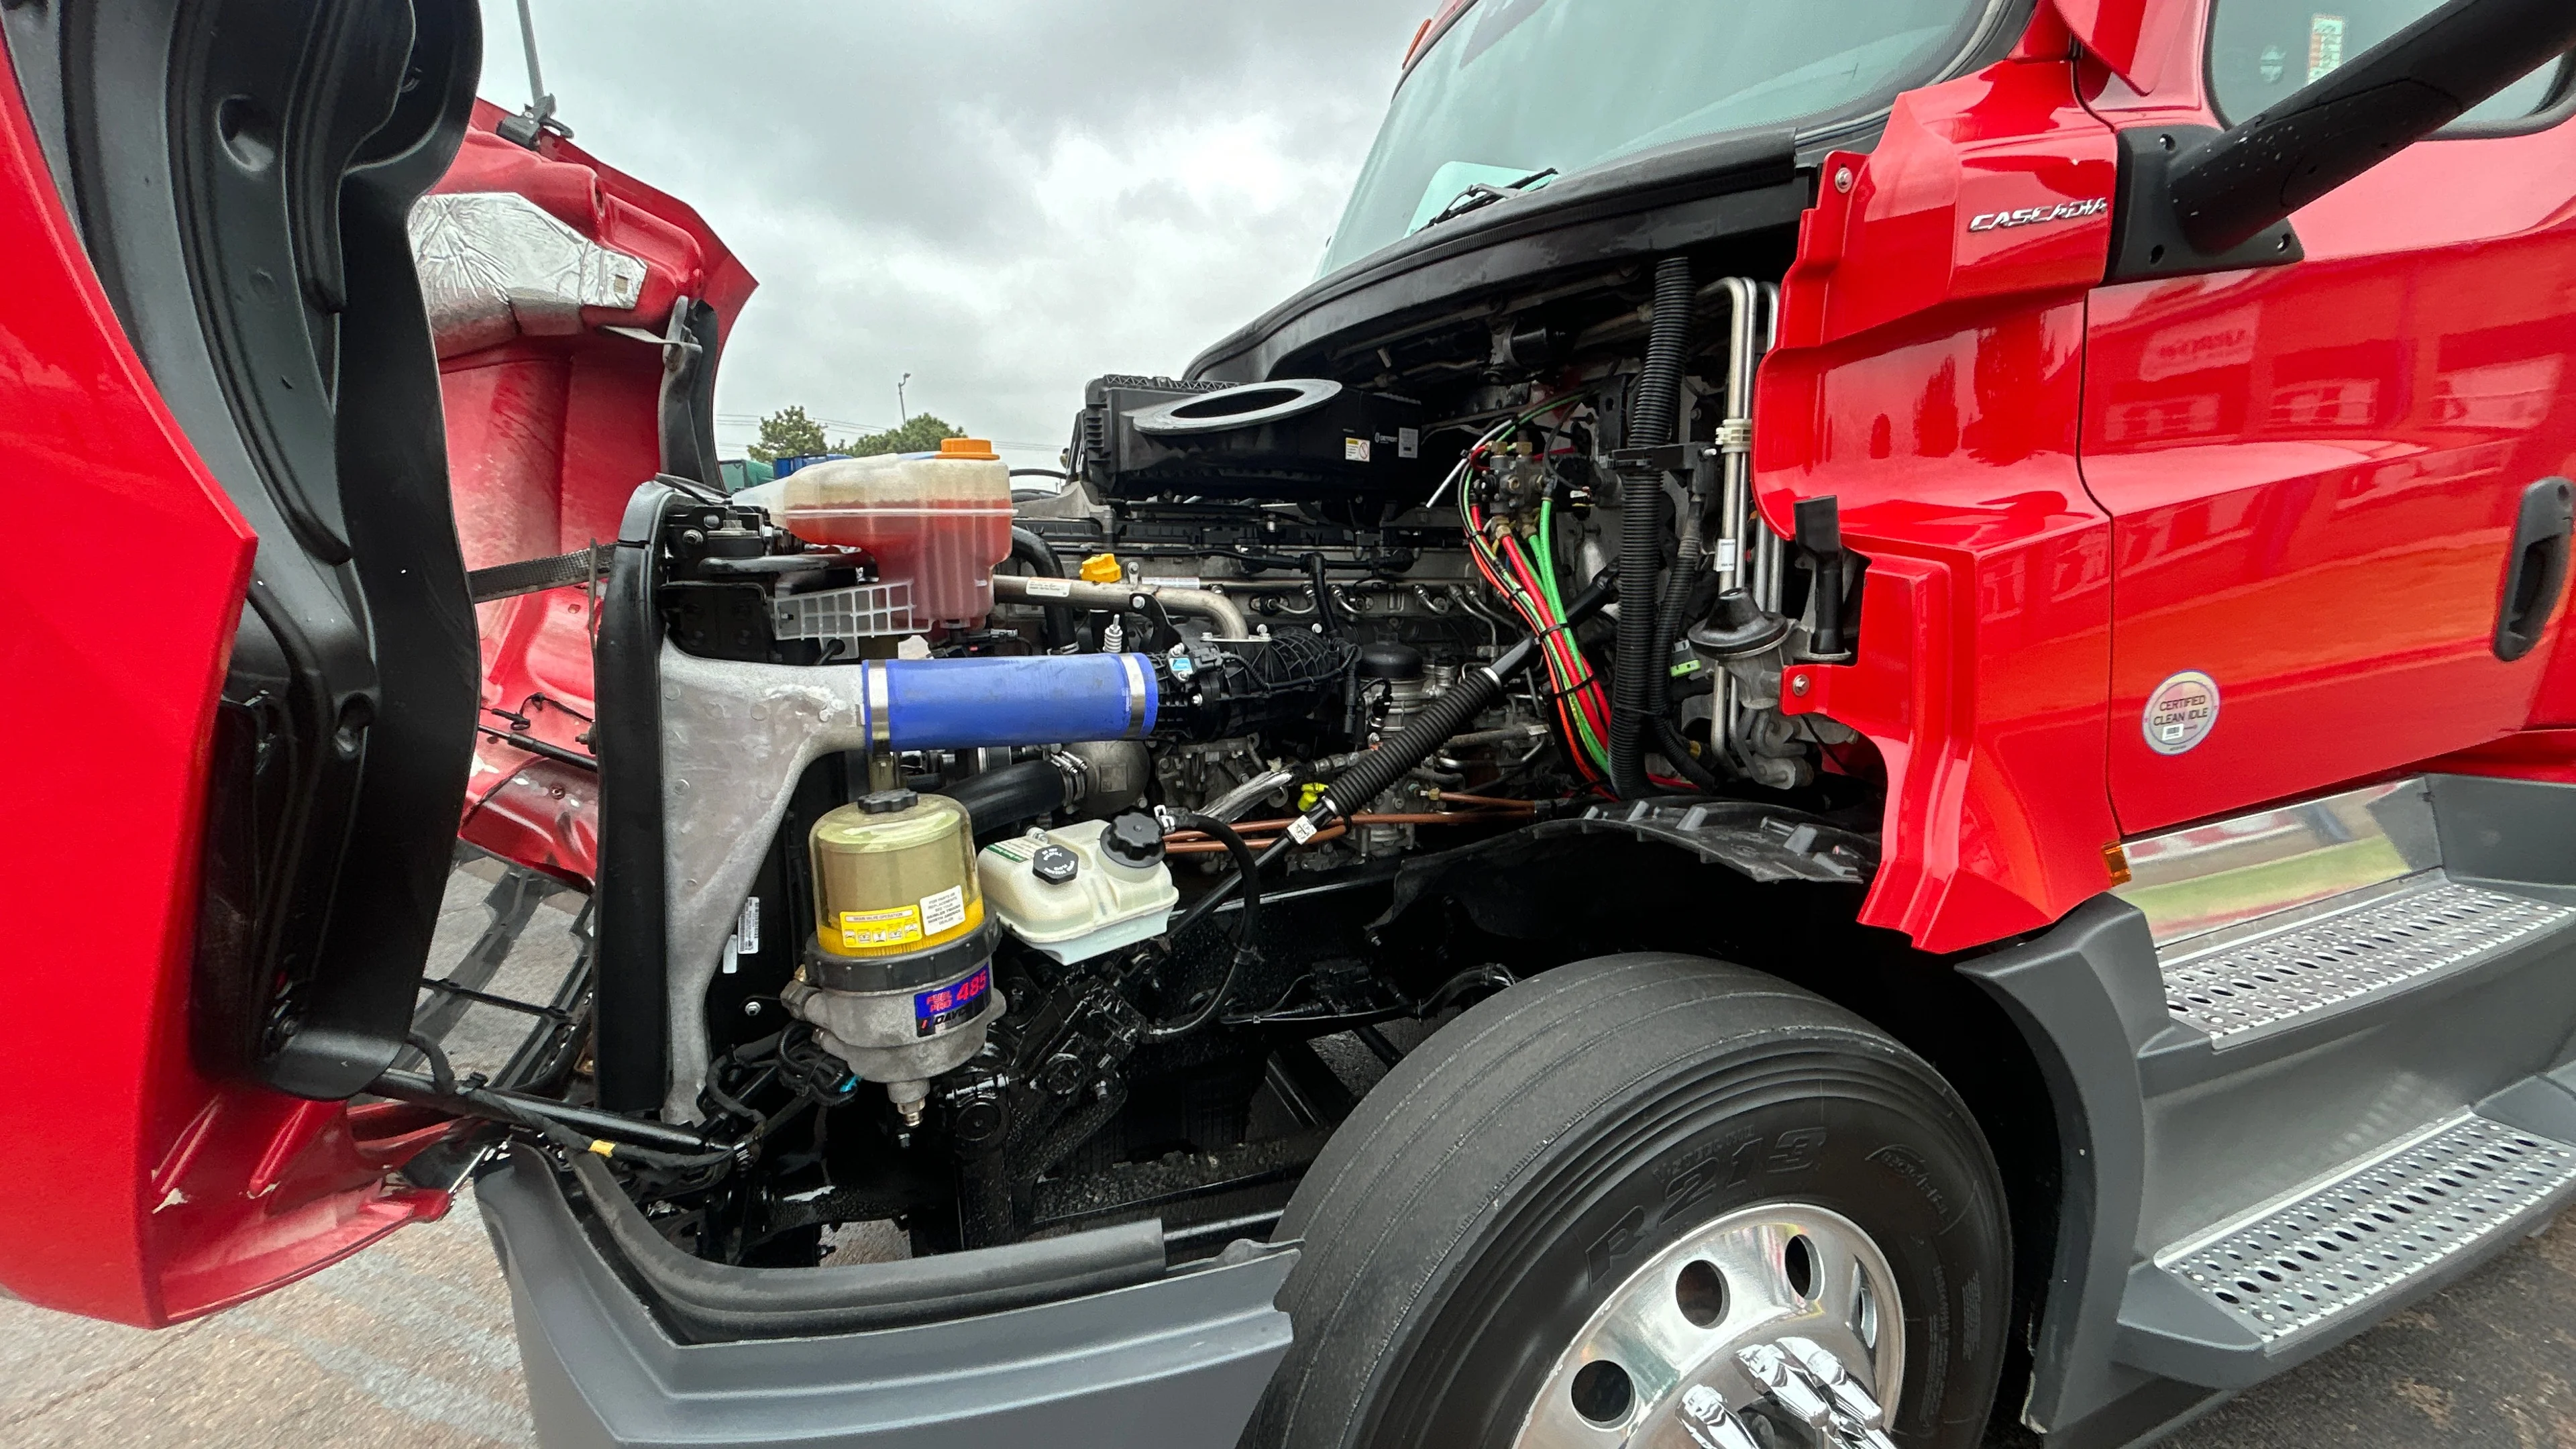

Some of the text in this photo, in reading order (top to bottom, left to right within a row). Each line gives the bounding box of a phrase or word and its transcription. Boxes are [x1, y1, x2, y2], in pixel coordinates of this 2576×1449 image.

[1968, 197, 2107, 232] CASCADIA
[2159, 694, 2206, 711] CERTIFIED
[2153, 707, 2208, 726] CLEAN IDLE
[956, 969, 986, 1000] 485
